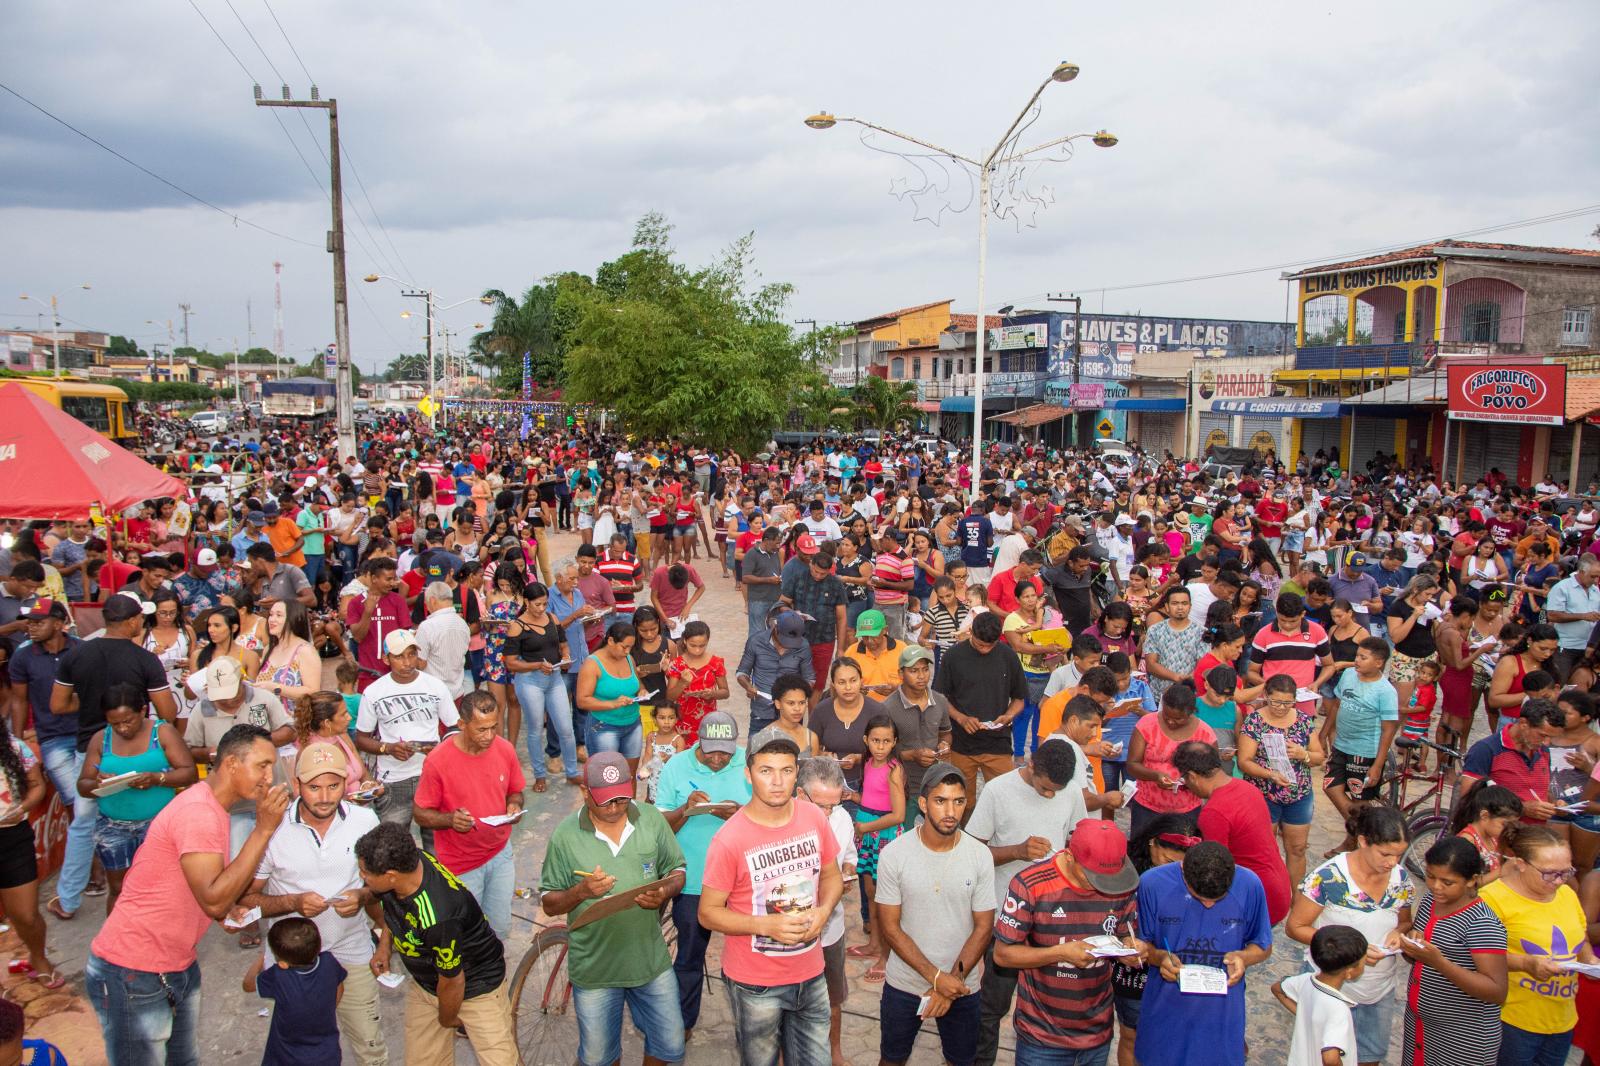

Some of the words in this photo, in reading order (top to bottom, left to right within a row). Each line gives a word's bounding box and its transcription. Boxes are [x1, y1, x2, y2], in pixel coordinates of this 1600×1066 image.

[1305, 272, 1339, 294] LIMA
[1060, 319, 1137, 343] CHAVES
[1139, 322, 1153, 344] &
[1154, 323, 1230, 346] PLACAS
[1215, 369, 1266, 397] PARAÍBA
[1470, 369, 1537, 395] FRIGORIFICO
[1495, 384, 1512, 395] DO
[1482, 395, 1527, 410] POVO
[966, 527, 979, 539] 35
[752, 839, 817, 871] LONGBEACH
[753, 857, 820, 882] CALIFORNIA
[998, 914, 1022, 929] user
[1056, 971, 1078, 979] Banco
